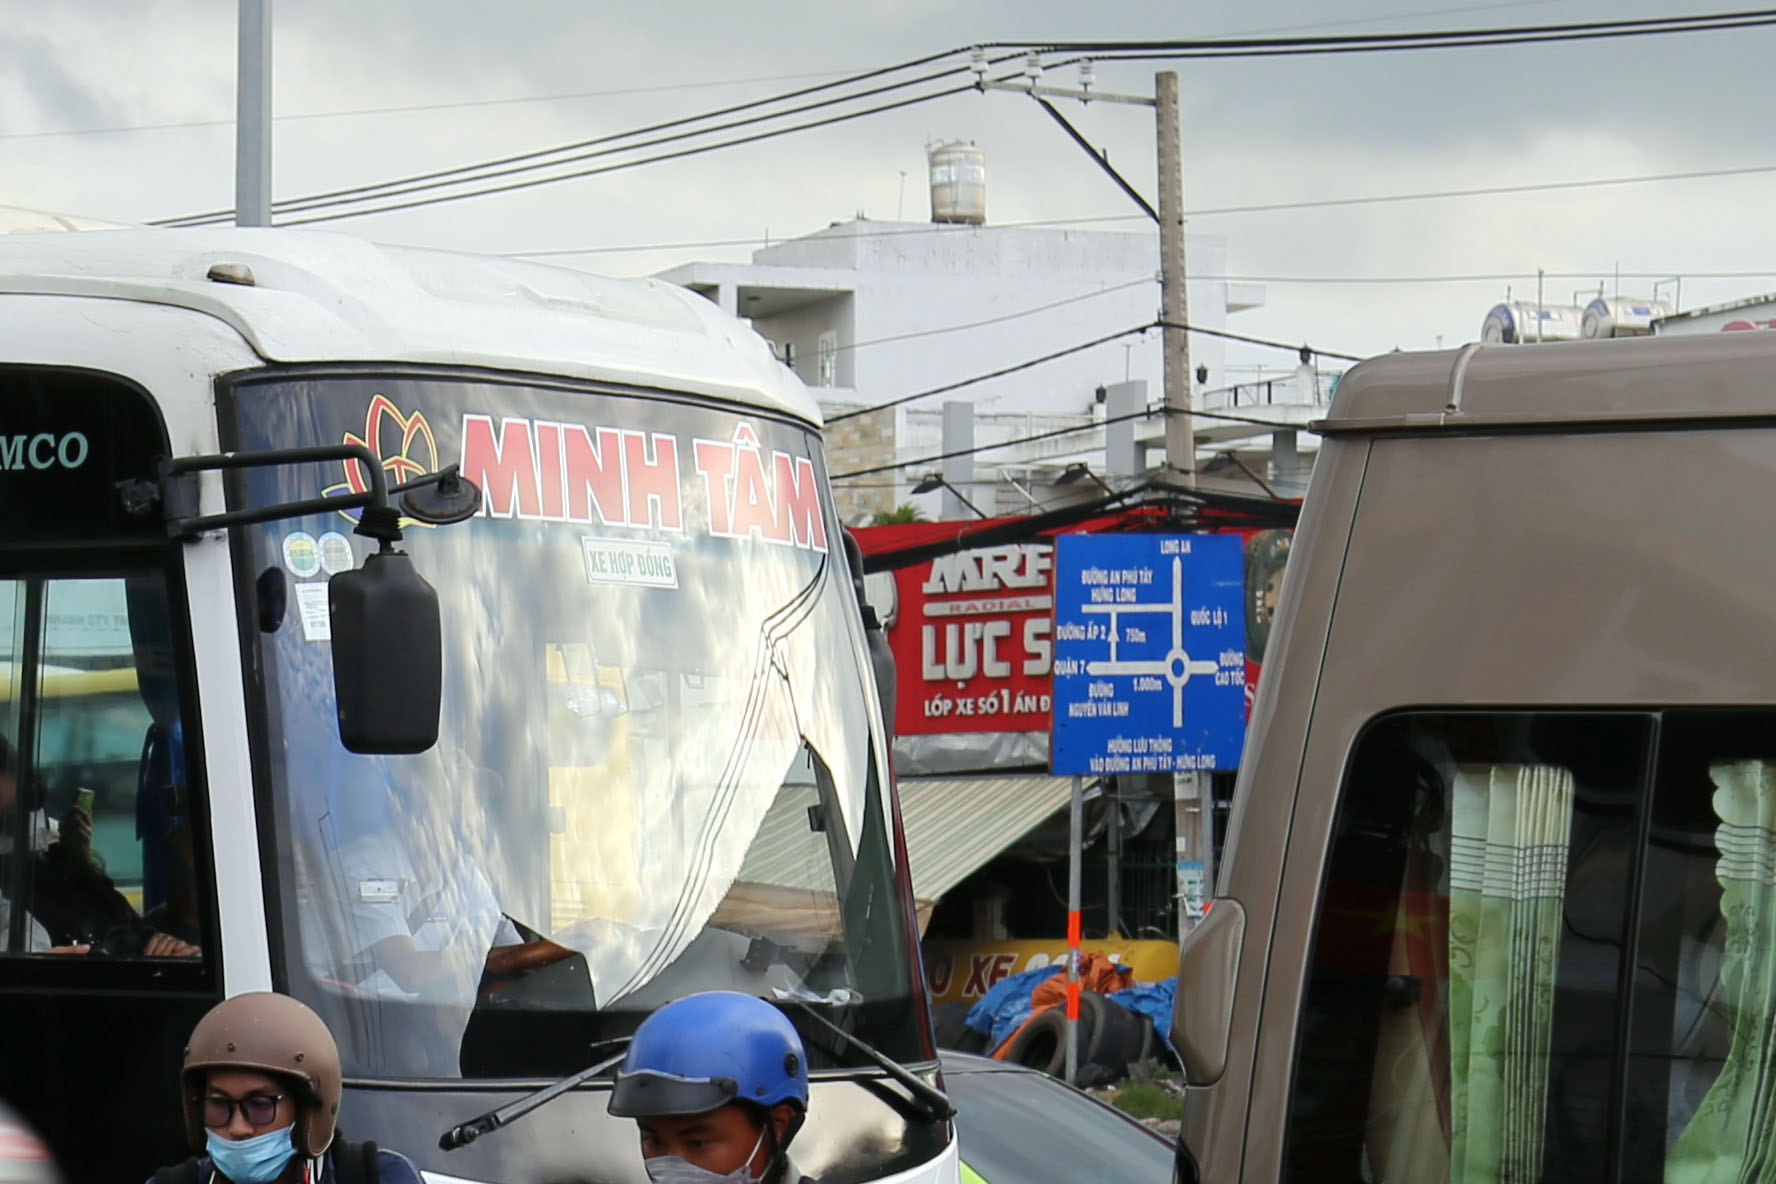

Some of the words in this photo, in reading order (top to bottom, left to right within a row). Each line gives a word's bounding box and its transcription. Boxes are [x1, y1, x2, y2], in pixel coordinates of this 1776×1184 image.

[460, 413, 683, 532] MINH
[693, 421, 828, 553] TÂM
[1160, 540, 1180, 554] LONG
[1181, 540, 1191, 554] AN
[588, 550, 608, 573] XE
[609, 550, 634, 580] HỢP
[922, 543, 1053, 594] MRF
[1109, 569, 1121, 584] AN
[1116, 588, 1136, 602] LONG
[949, 600, 1036, 614] RADIAL
[1100, 625, 1106, 640] 2
[922, 620, 1011, 689] LỰC
[1054, 657, 1079, 679] QUẬN
[1080, 660, 1086, 674] 7
[1215, 671, 1230, 686] CAO
[955, 699, 974, 716] XE
[1000, 689, 1011, 713] 1
[1113, 701, 1129, 717] LINH
